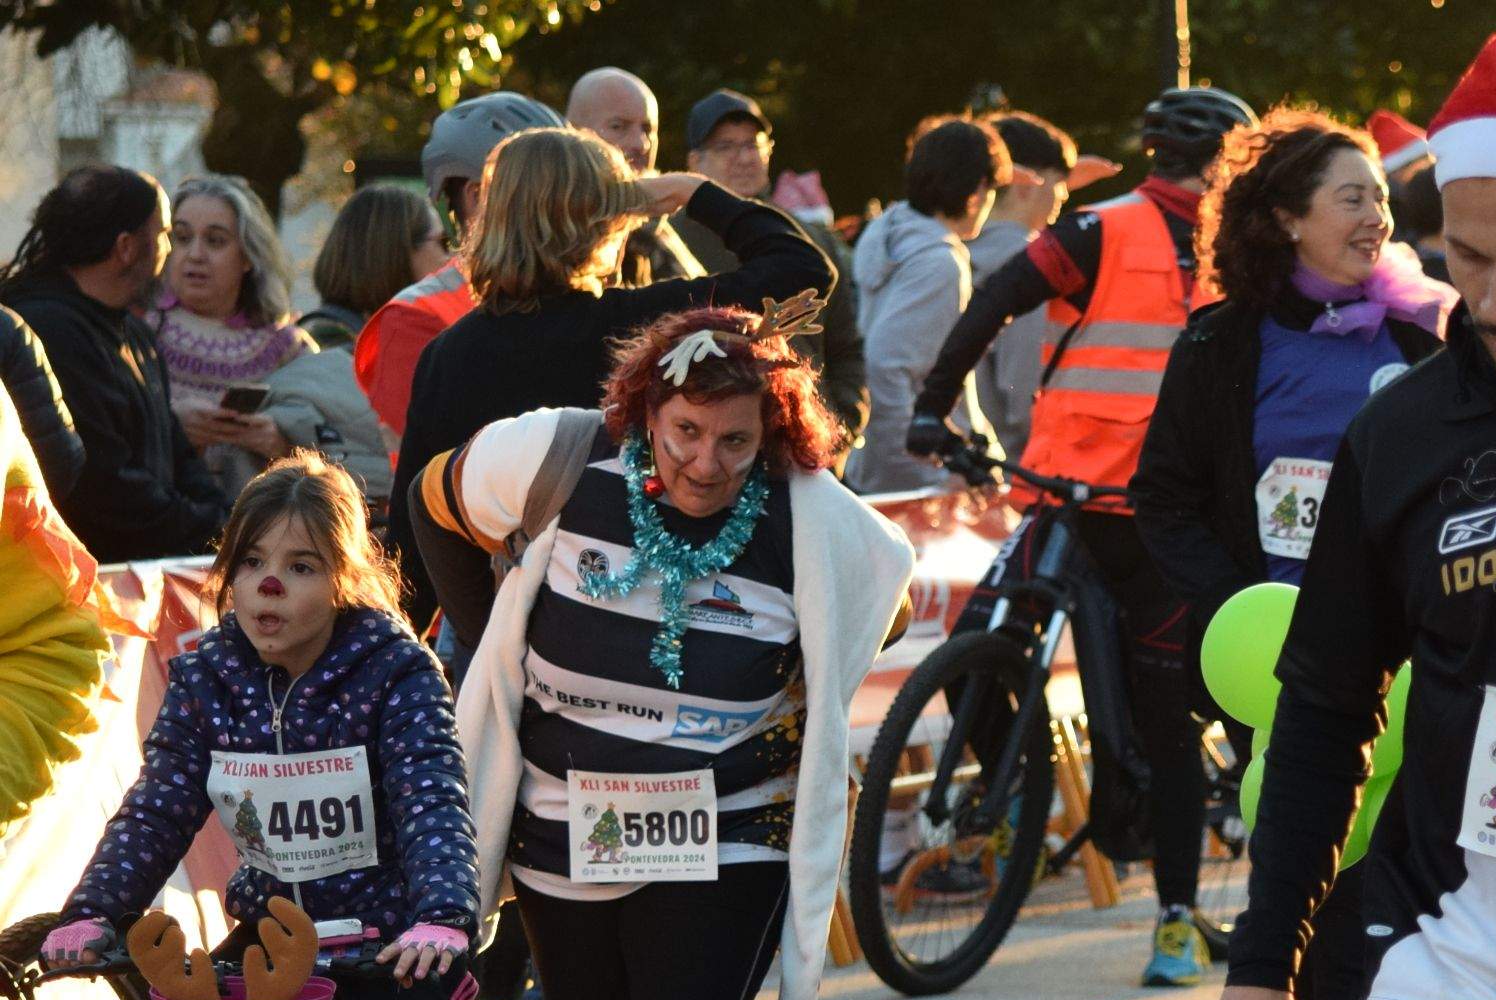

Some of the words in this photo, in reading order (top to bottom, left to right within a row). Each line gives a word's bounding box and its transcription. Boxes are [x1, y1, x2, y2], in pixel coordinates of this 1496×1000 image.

[557, 690, 610, 711] BEST
[617, 703, 663, 722] RUN
[677, 711, 752, 737] SAP
[223, 760, 242, 777] XLI
[244, 763, 269, 778] SAN
[274, 757, 354, 778] SILVESTRE
[580, 779, 599, 791] XLI
[604, 779, 629, 792] SAN
[635, 777, 700, 793] SILVESTRE
[268, 795, 364, 842] 4491
[624, 809, 709, 847] 5800
[269, 847, 336, 861] PONTEVEDRA
[339, 842, 364, 853] 2024
[624, 853, 680, 864] PONTEVEDRA
[684, 854, 705, 863] 2024
